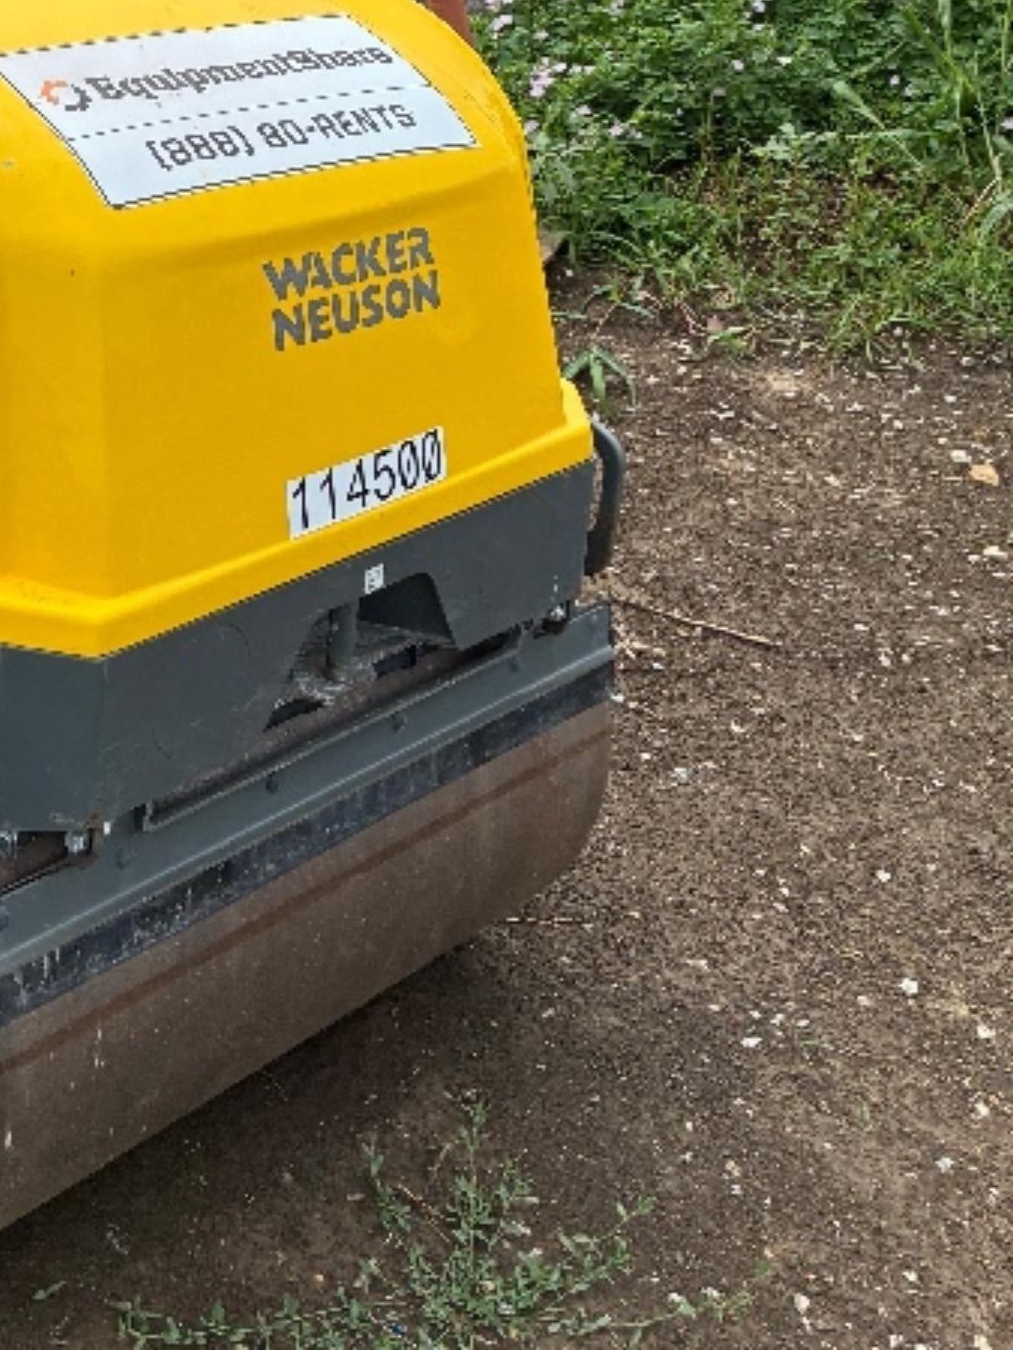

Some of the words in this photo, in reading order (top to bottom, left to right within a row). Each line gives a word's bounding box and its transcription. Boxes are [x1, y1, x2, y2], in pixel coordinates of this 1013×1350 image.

[85, 47, 394, 99] EquipmentShare
[145, 125, 255, 172] (888)
[256, 103, 418, 149] 80-RENTS
[262, 226, 436, 302] WACKER
[271, 269, 442, 352] NEUSON
[291, 428, 442, 531] 114500
